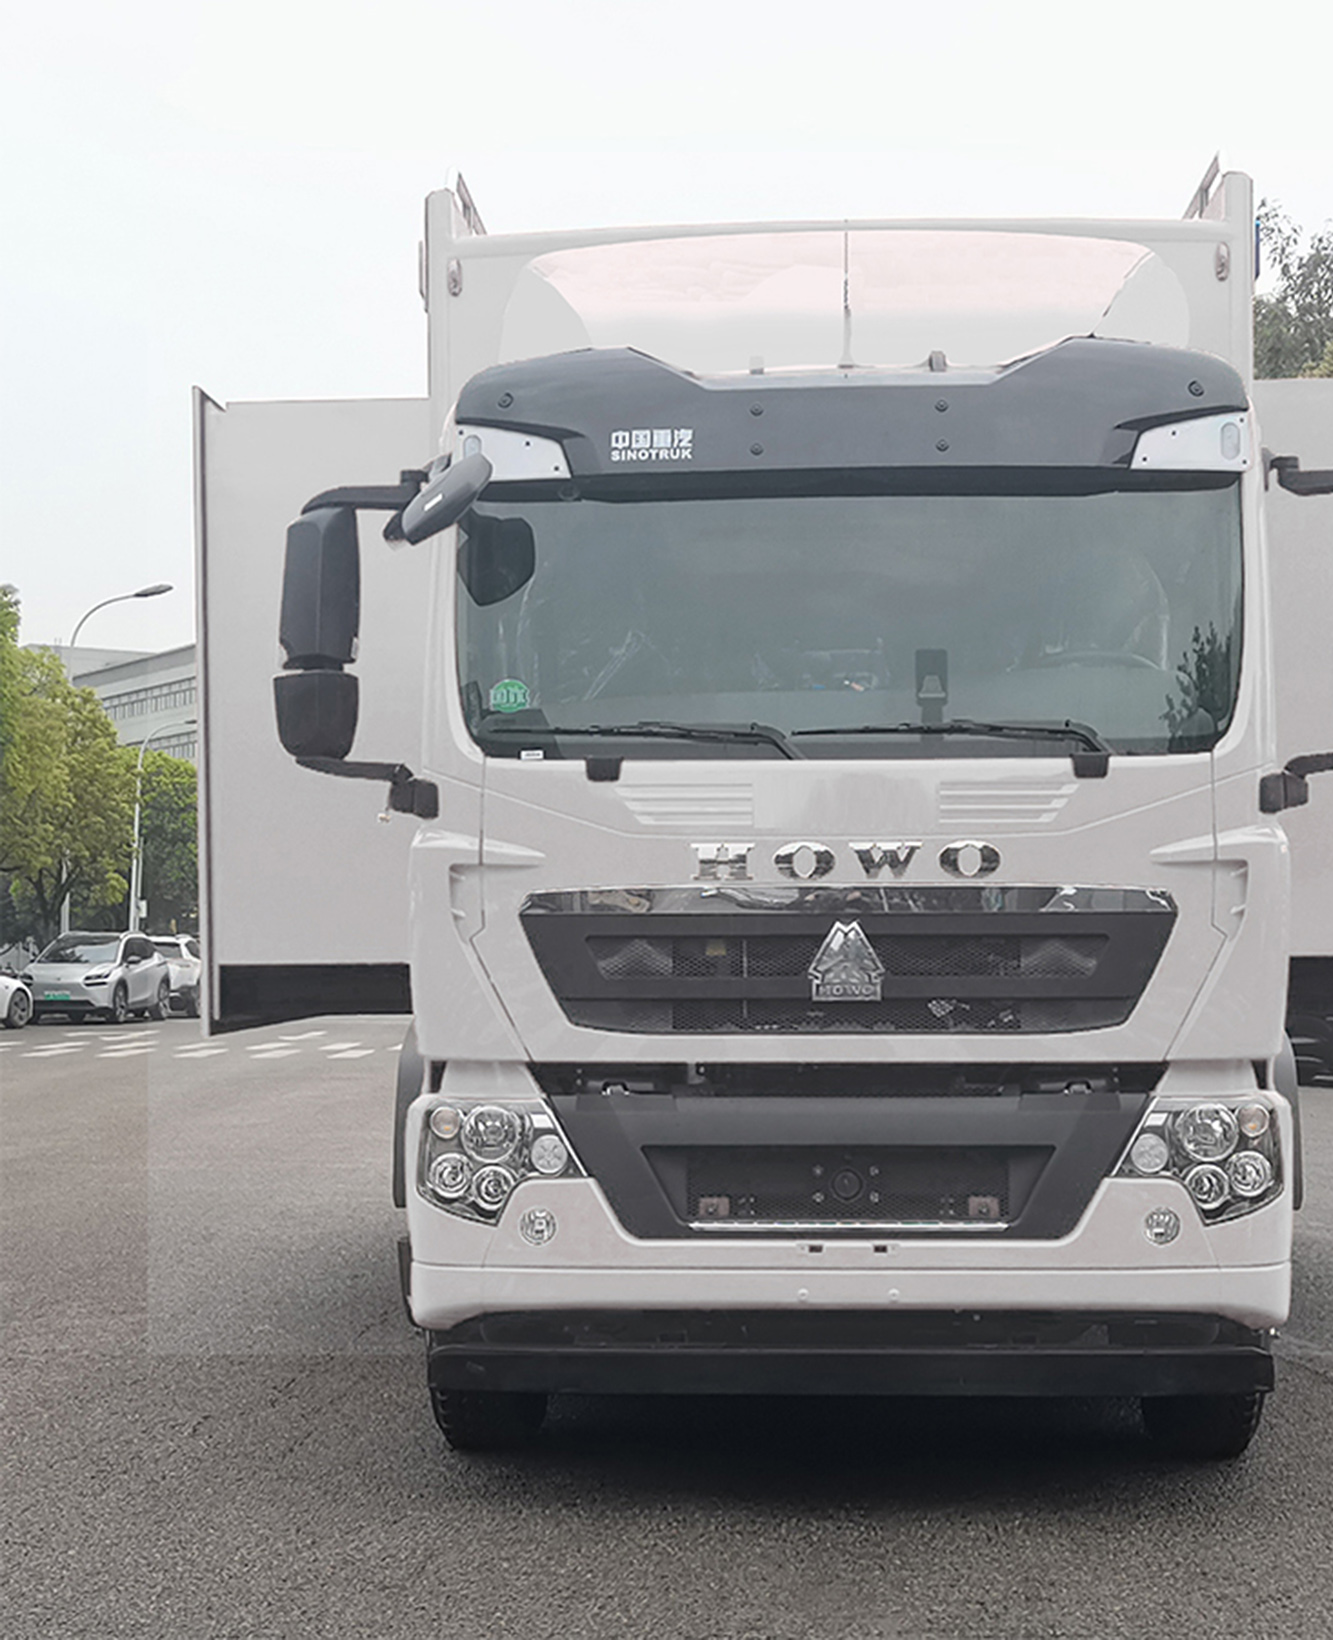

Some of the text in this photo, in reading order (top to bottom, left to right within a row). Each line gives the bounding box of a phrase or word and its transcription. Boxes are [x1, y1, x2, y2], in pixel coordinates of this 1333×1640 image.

[611, 429, 693, 448] 中国重汽
[611, 449, 692, 461] SINOTRUK
[691, 840, 1001, 881] HOWO
[819, 984, 874, 996] HOWO
